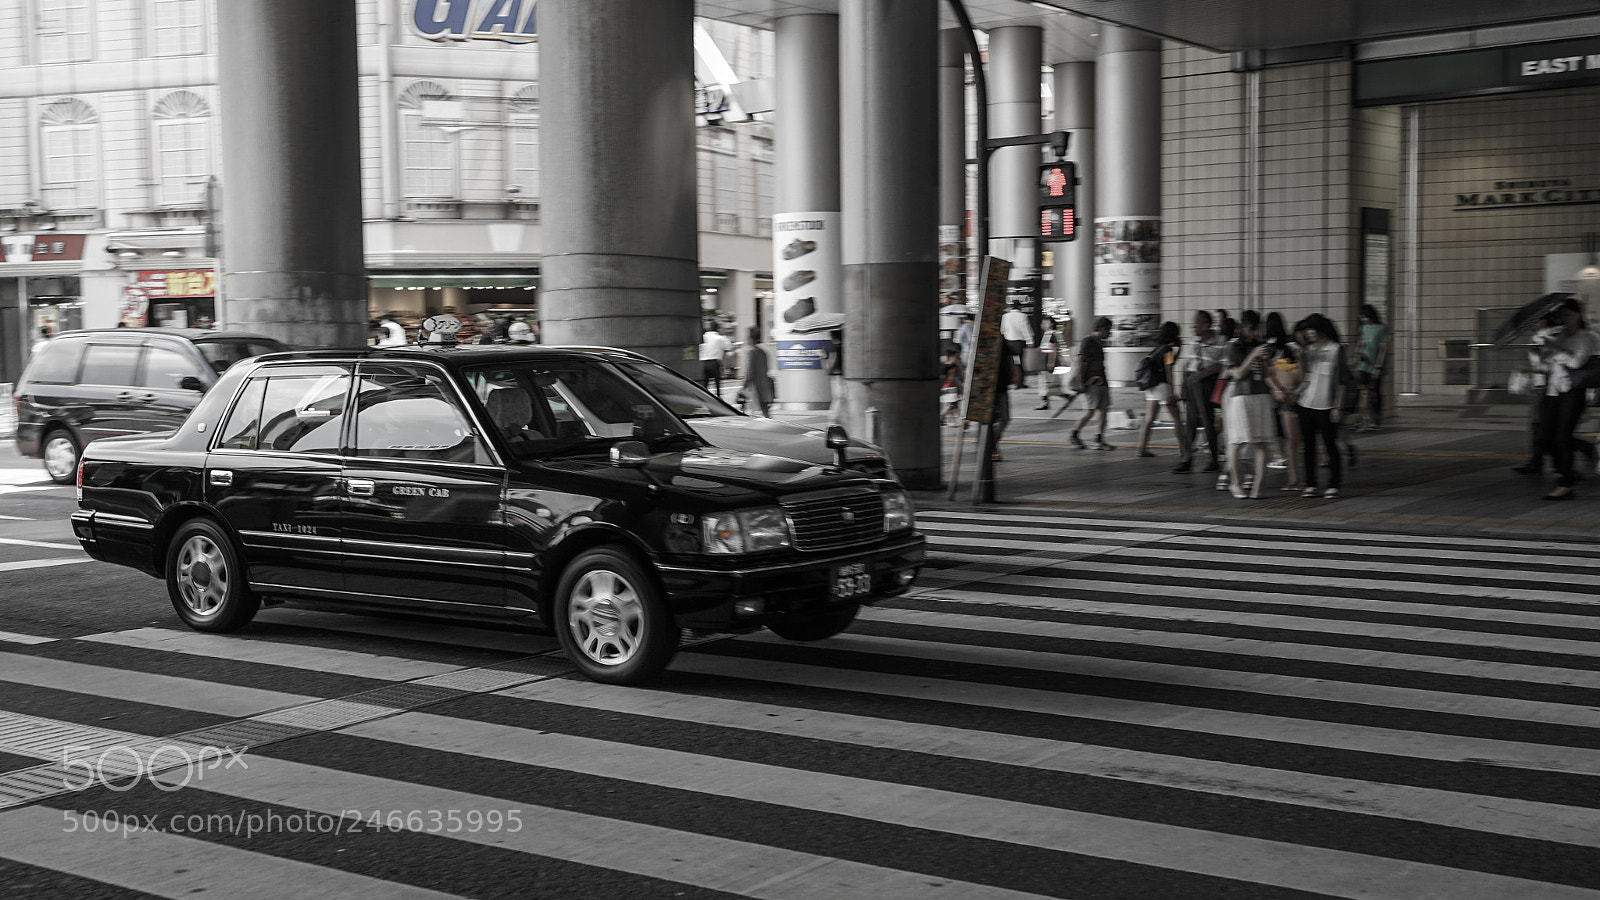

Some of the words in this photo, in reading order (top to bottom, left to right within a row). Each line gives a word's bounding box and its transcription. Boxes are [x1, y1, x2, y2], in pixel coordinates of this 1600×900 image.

[1521, 55, 1584, 76] EAST
[392, 486, 426, 496] GREEN
[428, 487, 450, 498] CAB
[271, 522, 292, 533] TAXI
